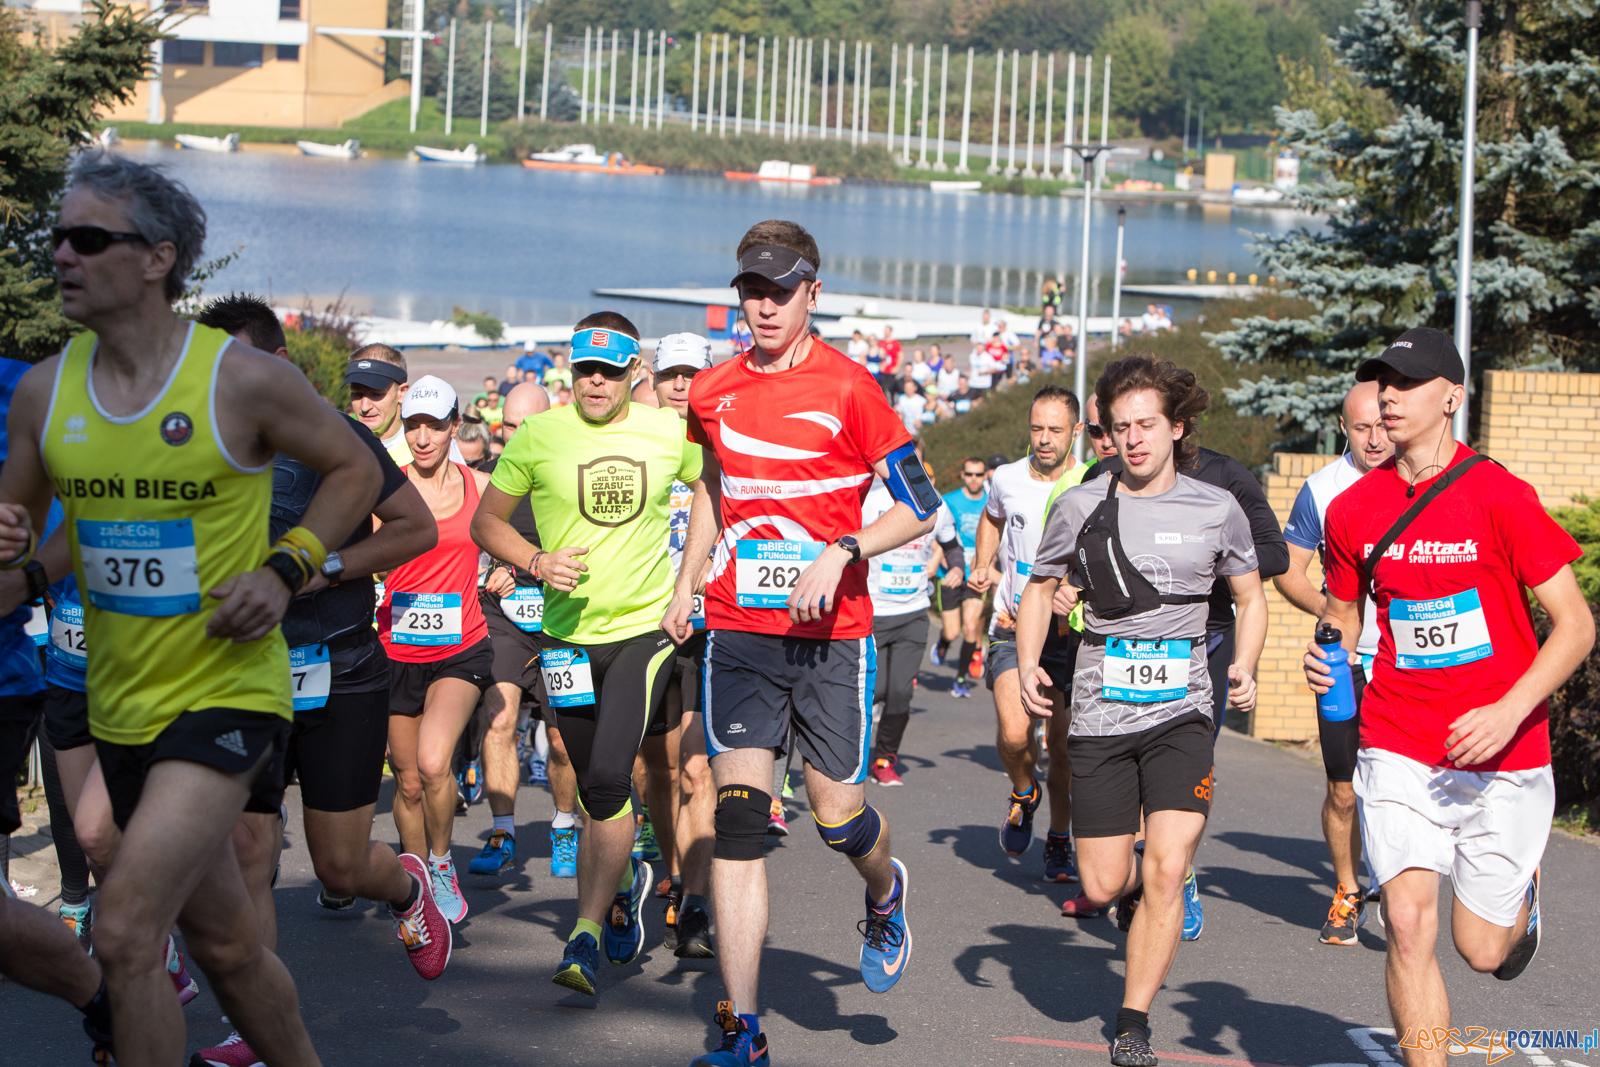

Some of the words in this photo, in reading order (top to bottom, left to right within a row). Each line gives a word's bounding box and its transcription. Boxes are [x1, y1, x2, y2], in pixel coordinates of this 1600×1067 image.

[54, 473, 125, 498] UBOŃ
[135, 478, 217, 500] BIEGA
[592, 482, 624, 490] CZASU
[592, 490, 633, 504] TRE
[99, 524, 160, 539] zaBIEGaj
[757, 541, 802, 554] zaBIEGaj
[1408, 540, 1478, 555] Attack
[763, 552, 802, 560] FUNdusze
[1408, 555, 1433, 564] SPORTS
[1436, 553, 1478, 564] NUTRITION
[105, 557, 164, 587] 376
[757, 566, 801, 588] 262
[891, 575, 912, 586] 335
[408, 594, 444, 603] zaBIEGaj
[1407, 597, 1455, 612] zaBIEGaj
[516, 604, 544, 618] 459
[1415, 609, 1456, 620] FUNdusze
[67, 616, 84, 625] FUN
[408, 612, 444, 630] 233
[64, 628, 87, 652] 12
[1414, 622, 1459, 648] 567
[292, 672, 307, 691] 7
[547, 670, 574, 691] 293
[1125, 664, 1168, 684] 194
